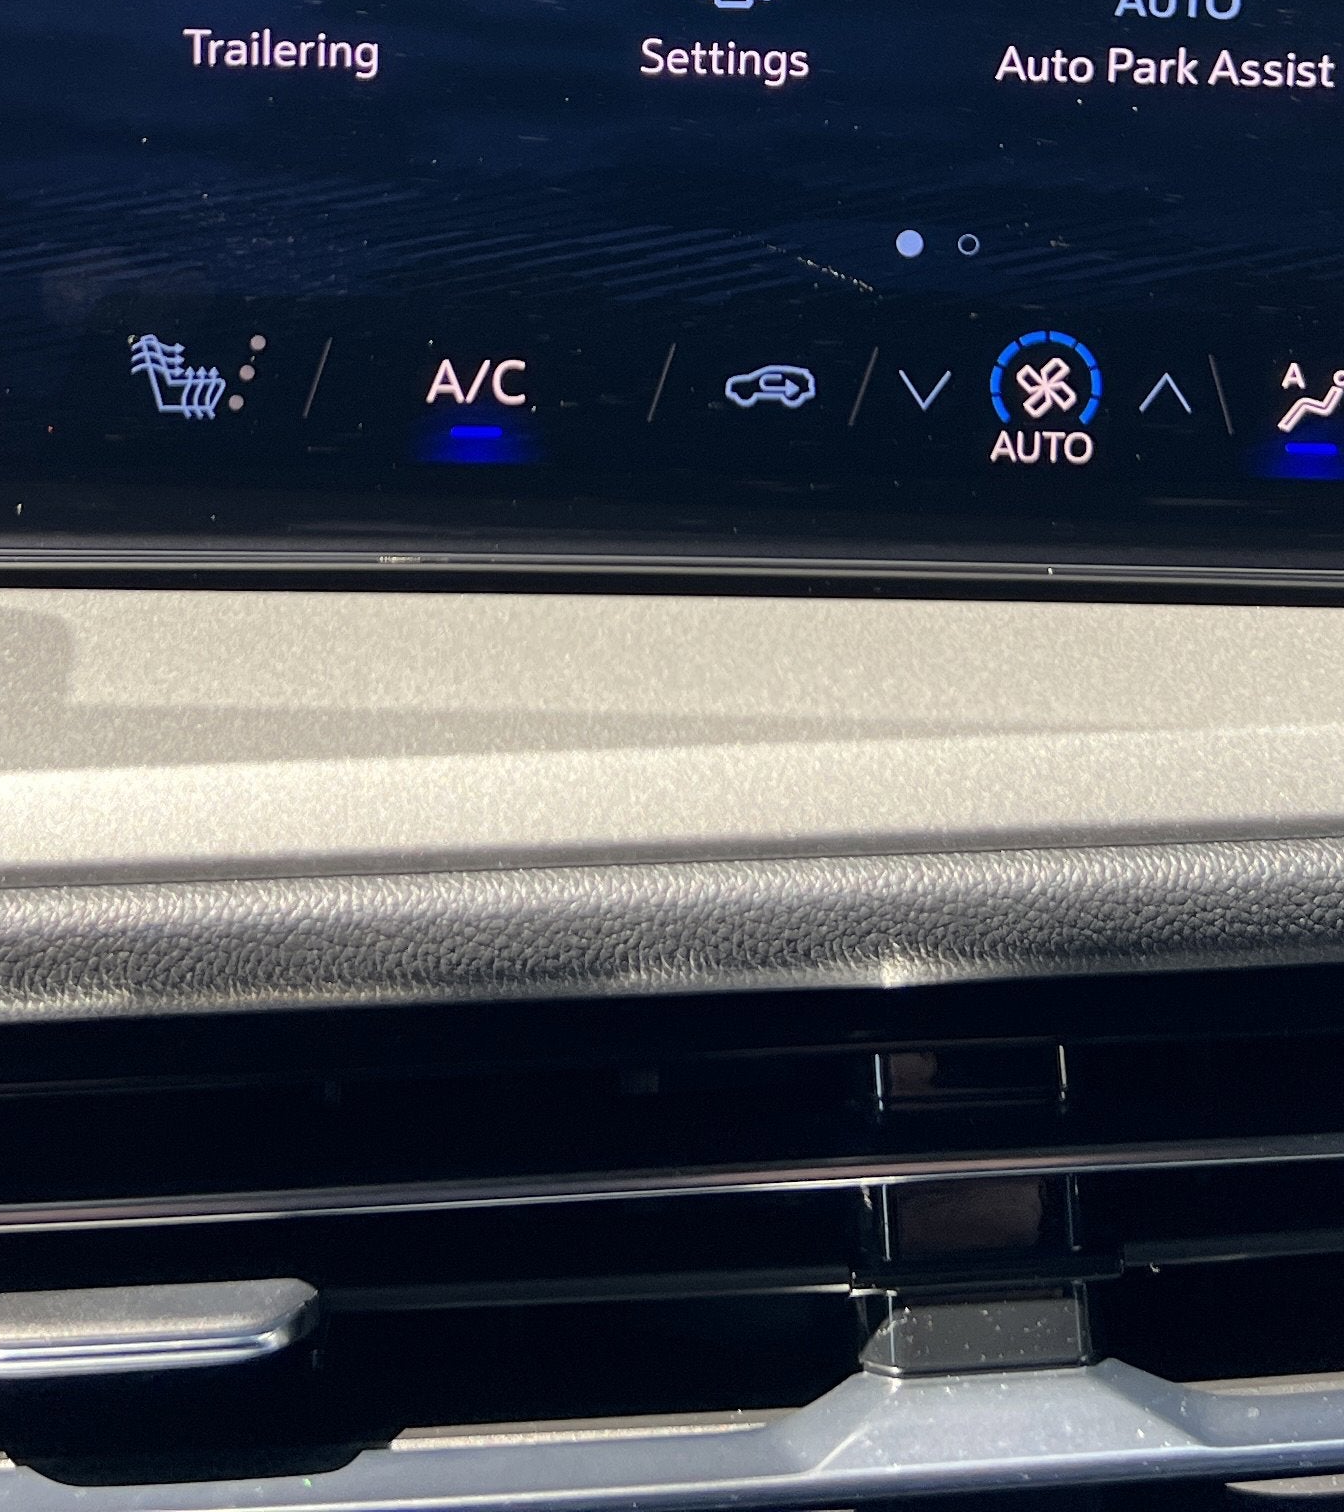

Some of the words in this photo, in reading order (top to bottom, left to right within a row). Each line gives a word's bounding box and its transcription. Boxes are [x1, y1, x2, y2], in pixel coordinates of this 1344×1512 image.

[181, 27, 380, 80] Trailering
[639, 36, 810, 88] Settings
[993, 44, 1095, 84] Auto
[1106, 45, 1200, 86] Park
[1206, 48, 1337, 89] Assist
[425, 357, 527, 406] A/C
[1280, 361, 1306, 390] A
[989, 429, 1094, 464] AUTO
